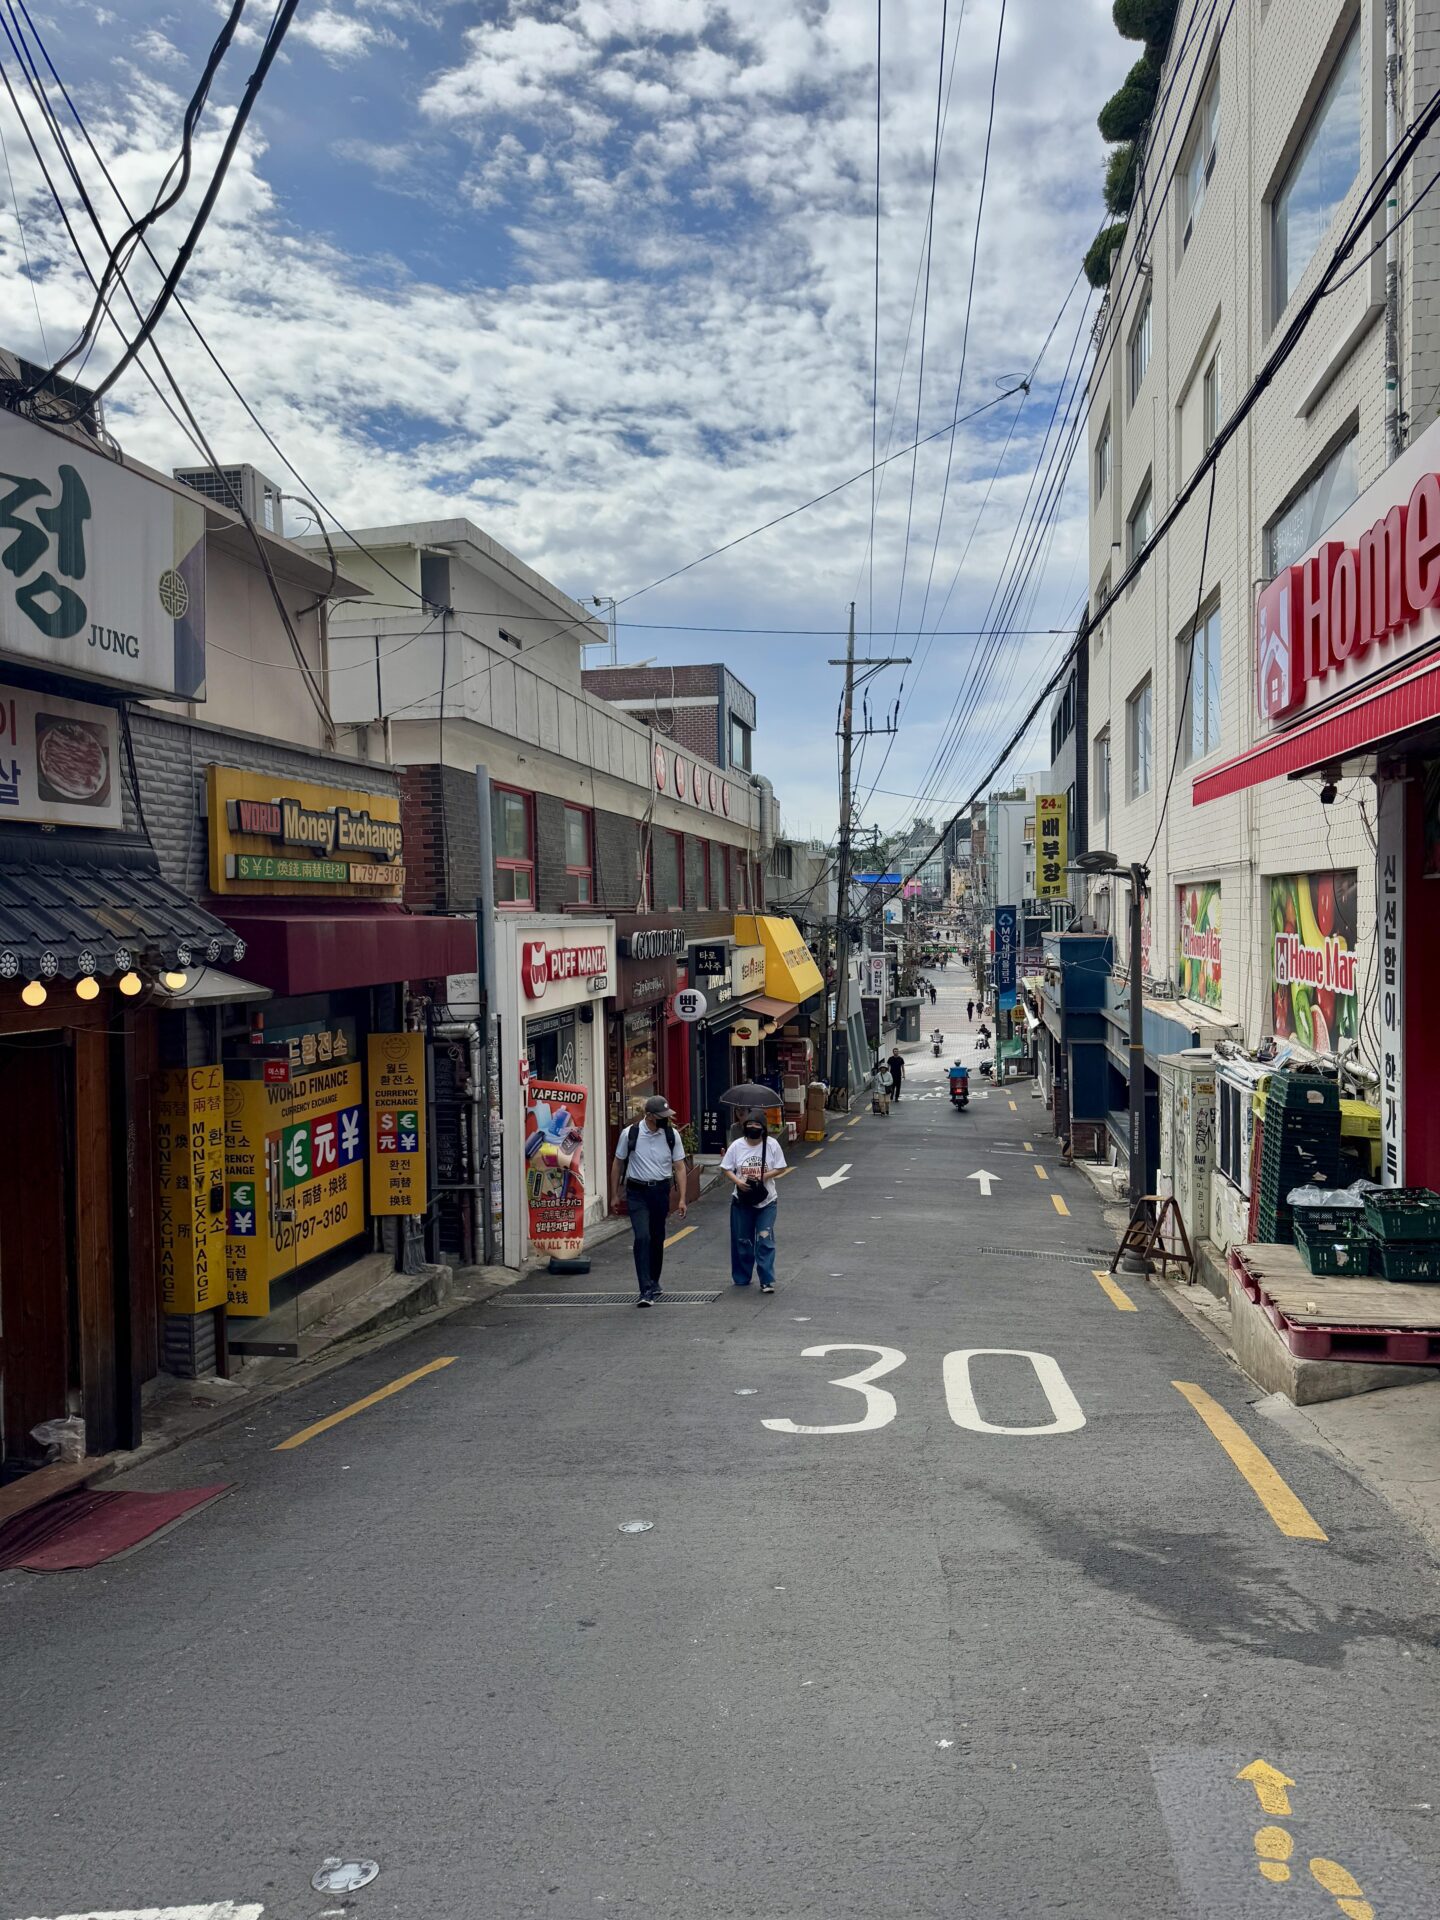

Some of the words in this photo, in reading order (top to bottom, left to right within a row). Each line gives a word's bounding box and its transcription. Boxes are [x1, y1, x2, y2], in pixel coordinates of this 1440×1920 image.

[0, 464, 92, 639] 정
[1303, 473, 1440, 682] Home
[88, 624, 139, 659] JUNG
[239, 801, 281, 833] WORLD
[284, 804, 336, 852] Money
[338, 811, 402, 857] Exchange
[1042, 817, 1061, 882] 배부장
[240, 857, 249, 876] $
[264, 860, 274, 877] £
[352, 866, 405, 884] T.797-3181
[699, 951, 717, 960] 타로
[1001, 926, 1010, 984] MG새마을금고
[1384, 855, 1397, 1031] 신선함이
[551, 951, 576, 980] PUFF
[578, 946, 608, 975] MANIA
[1289, 935, 1324, 985] Home
[680, 994, 698, 1013] 빵
[191, 1070, 205, 1091] €
[208, 1068, 221, 1089] £
[381, 1075, 415, 1085] 환전소
[386, 1063, 408, 1073] 월드
[267, 1081, 306, 1105] WORLD
[309, 1069, 348, 1094] FINANCE
[375, 1089, 418, 1098] CURRENCY
[530, 1088, 584, 1104] VAPESHOP
[281, 1101, 310, 1118] CURRENCY
[311, 1093, 338, 1109] EXCHANGE
[375, 1099, 418, 1107] EXCHANGE
[381, 1114, 394, 1130] $
[400, 1113, 415, 1129] €
[1384, 1052, 1397, 1184] 한가득
[192, 1121, 206, 1189] MONEY
[224, 1135, 251, 1148] 전소
[286, 1129, 308, 1177] €
[314, 1122, 336, 1168] 元
[341, 1109, 359, 1160] ¥
[379, 1136, 396, 1150] 元
[401, 1133, 416, 1150] ¥
[158, 1123, 172, 1190] MONEY
[224, 1154, 255, 1164] RENCY
[389, 1160, 411, 1171] 환전
[208, 1127, 224, 1234] 환전소
[233, 1185, 251, 1205] €
[235, 1211, 252, 1233] ¥
[275, 1201, 348, 1252] 02)797-3180
[160, 1196, 175, 1303] EXCHANGE
[194, 1193, 208, 1303] EXCHANGE
[547, 1241, 562, 1250] ALL
[564, 1239, 581, 1250] TRY
[760, 1343, 1086, 1436] 30
